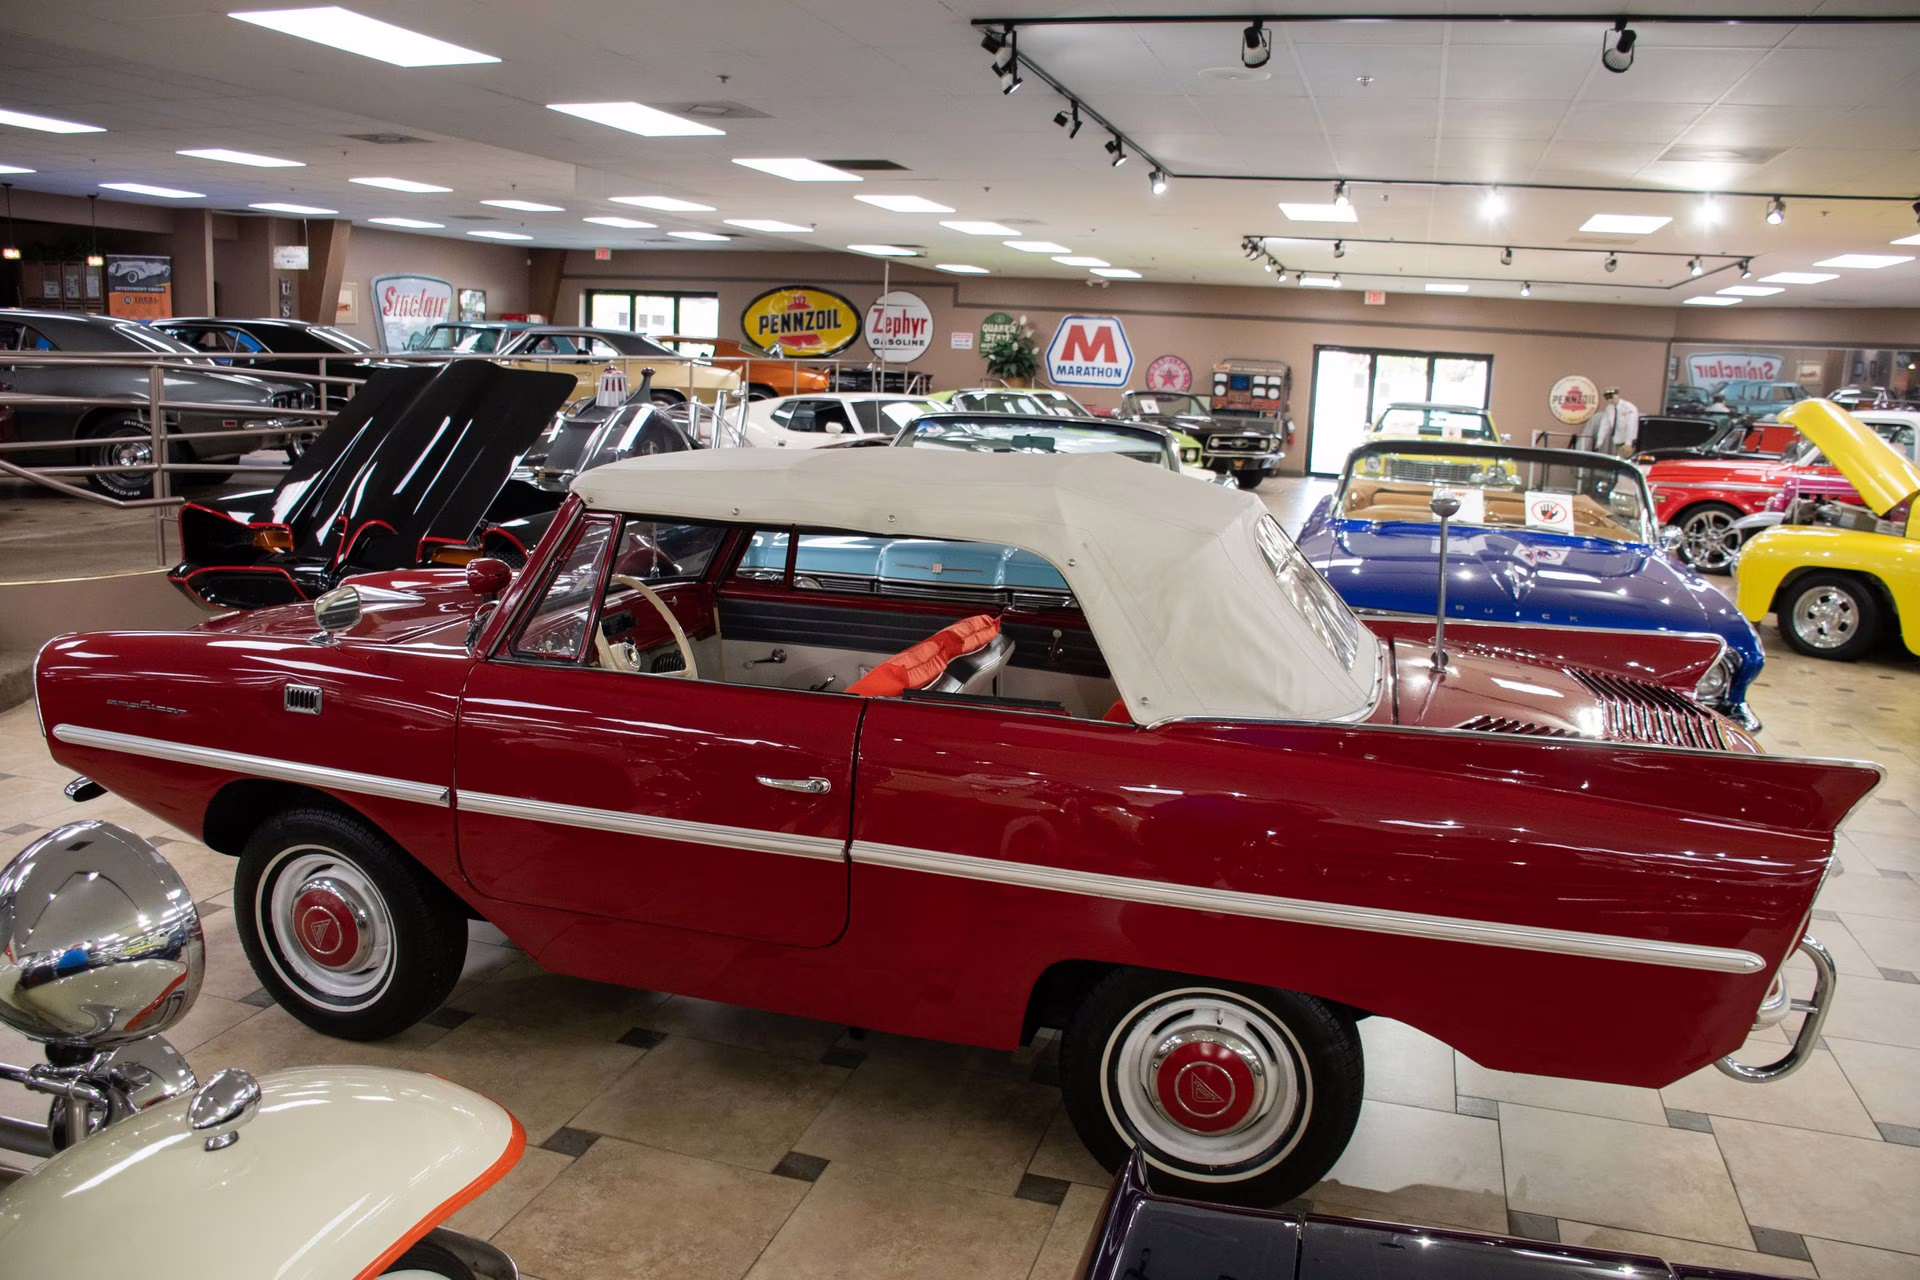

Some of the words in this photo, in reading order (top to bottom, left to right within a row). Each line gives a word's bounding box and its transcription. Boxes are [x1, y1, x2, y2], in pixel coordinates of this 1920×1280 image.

[383, 286, 449, 318] Sinclair
[758, 309, 842, 335] PENNZOIL
[872, 308, 928, 339] Zephyr
[982, 323, 1017, 334] QUAKER
[873, 338, 925, 347] GASOLINE
[1060, 325, 1118, 363] M
[1056, 365, 1122, 378] MARATHON
[1552, 394, 1596, 405] PENNZOIL
[123, 420, 152, 432] Radia
[1455, 604, 1579, 622] BUICK
